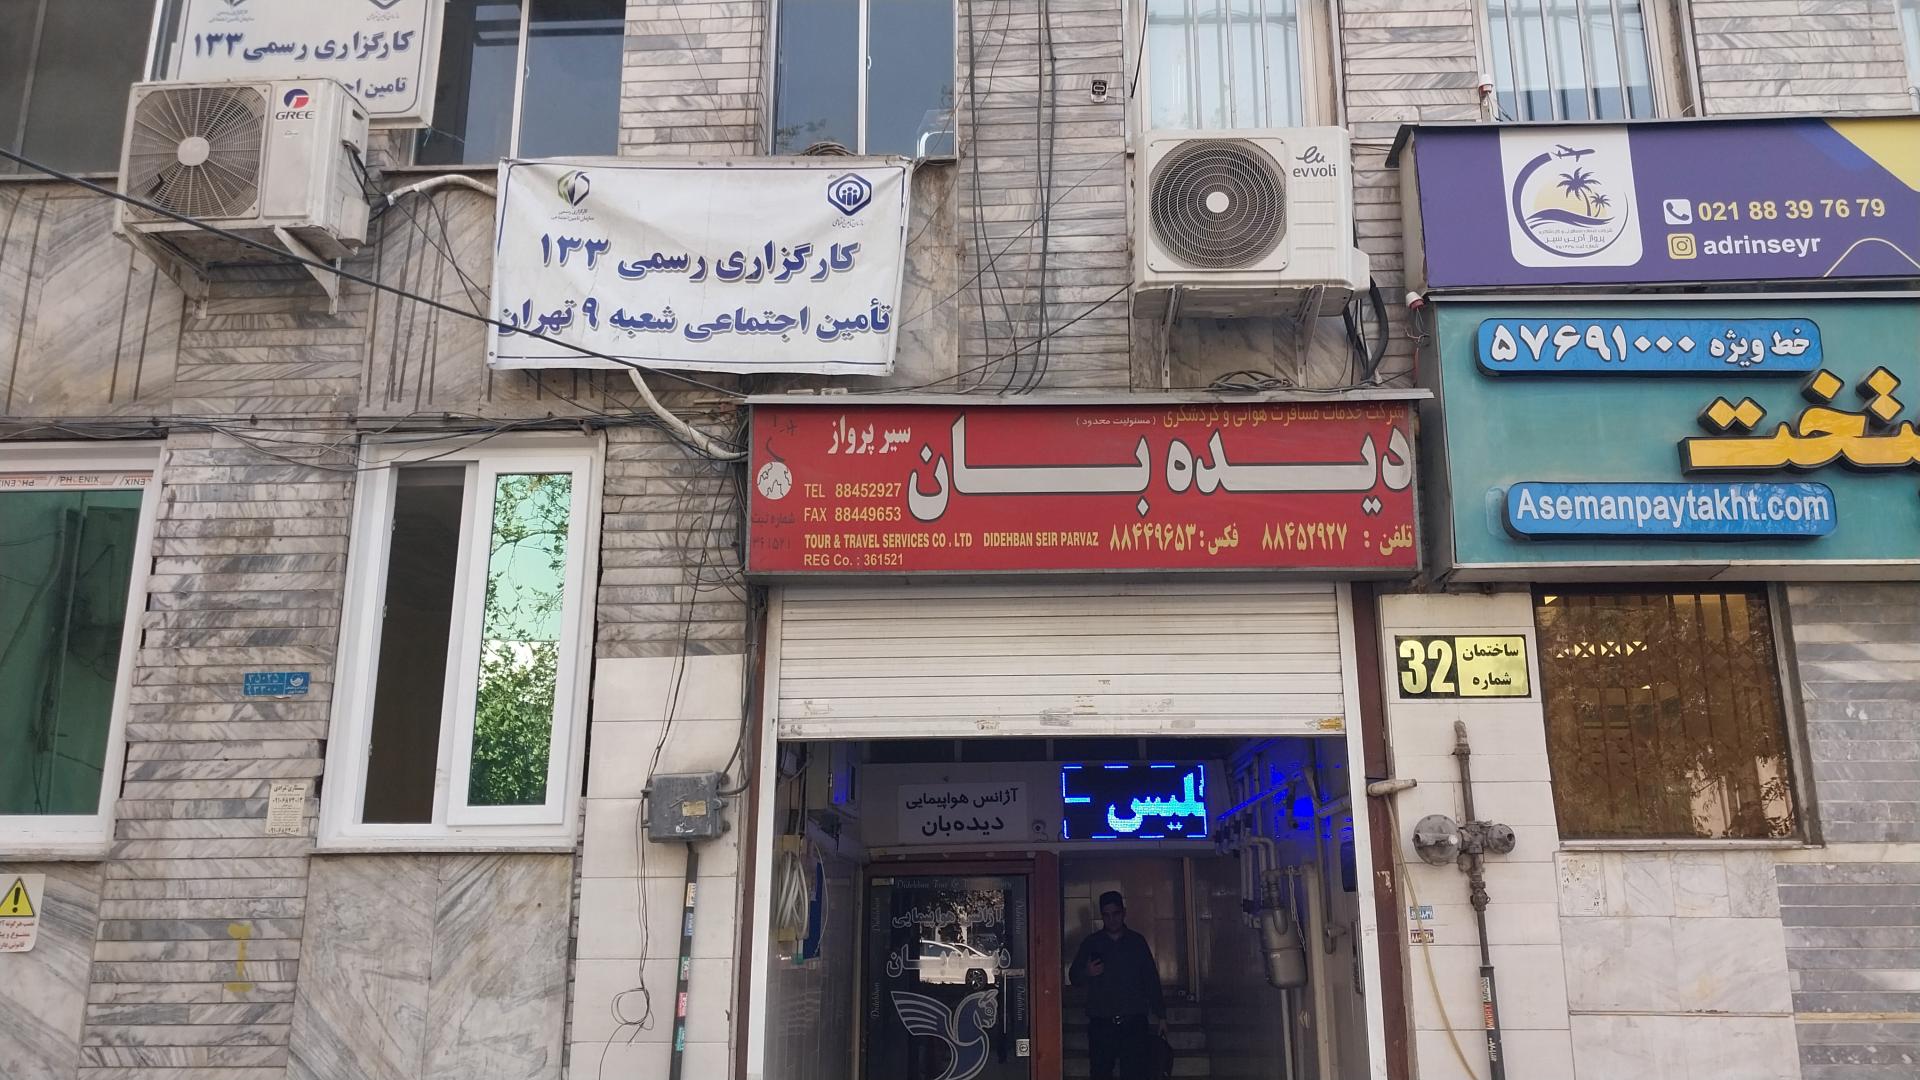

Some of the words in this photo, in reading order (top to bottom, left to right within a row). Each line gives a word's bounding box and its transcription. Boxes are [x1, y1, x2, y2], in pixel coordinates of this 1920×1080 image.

[194, 32, 244, 57] ۱۳۳
[243, 41, 308, 61] رسمی
[313, 30, 415, 60] کارگزاری
[364, 76, 407, 98] تامین
[275, 110, 316, 120] GREE
[1293, 164, 1337, 177] evvoli
[1698, 202, 1738, 221] 021
[1749, 201, 1777, 220] 88
[1784, 200, 1813, 219] 39
[1820, 200, 1850, 218] 76
[1856, 198, 1886, 218] 79
[540, 233, 611, 268] ۱۳۳
[1703, 234, 1820, 257] adrinseyr
[617, 253, 708, 281] رسمی
[715, 239, 861, 282] کارگزاری
[498, 297, 578, 337] تهران
[582, 297, 600, 330] ۹
[609, 305, 677, 339] شعبه
[683, 305, 809, 343] اجتماعی
[815, 297, 892, 342] تأمین
[1491, 323, 1696, 363] ۵۷۶۹۱۰۰۰
[1709, 329, 1766, 367] ویژه
[1770, 327, 1811, 356] خط
[827, 414, 875, 455] پرواز
[879, 426, 911, 454] سیر
[60, 476, 99, 484] PHENIX
[804, 484, 826, 498] TEL
[835, 483, 902, 498] 88452927
[804, 508, 827, 522] FAX
[834, 507, 902, 522] 88449653
[1516, 488, 1830, 528] Asemanpaytakht.com
[804, 534, 832, 548] TOUR
[833, 534, 841, 548] &
[843, 534, 880, 548] TRAVEL
[882, 533, 929, 548] SERVICES
[954, 533, 973, 547] LTD
[983, 532, 1033, 547] DIDEHBAN
[1035, 532, 1058, 547] SEIR
[1060, 531, 1099, 546] PARVAZ
[1110, 523, 1196, 551] ۸۸۴۴۹۶۵۳
[1262, 522, 1348, 551] ۸۸۴۵۲۹۲۷
[804, 554, 830, 566] REG
[863, 553, 904, 566] 361521
[1462, 643, 1519, 661] ساختمان
[1399, 640, 1455, 693] 32
[1472, 672, 1512, 690] شماره
[905, 792, 969, 810] هواپیمایی
[973, 787, 1019, 808] آژانس
